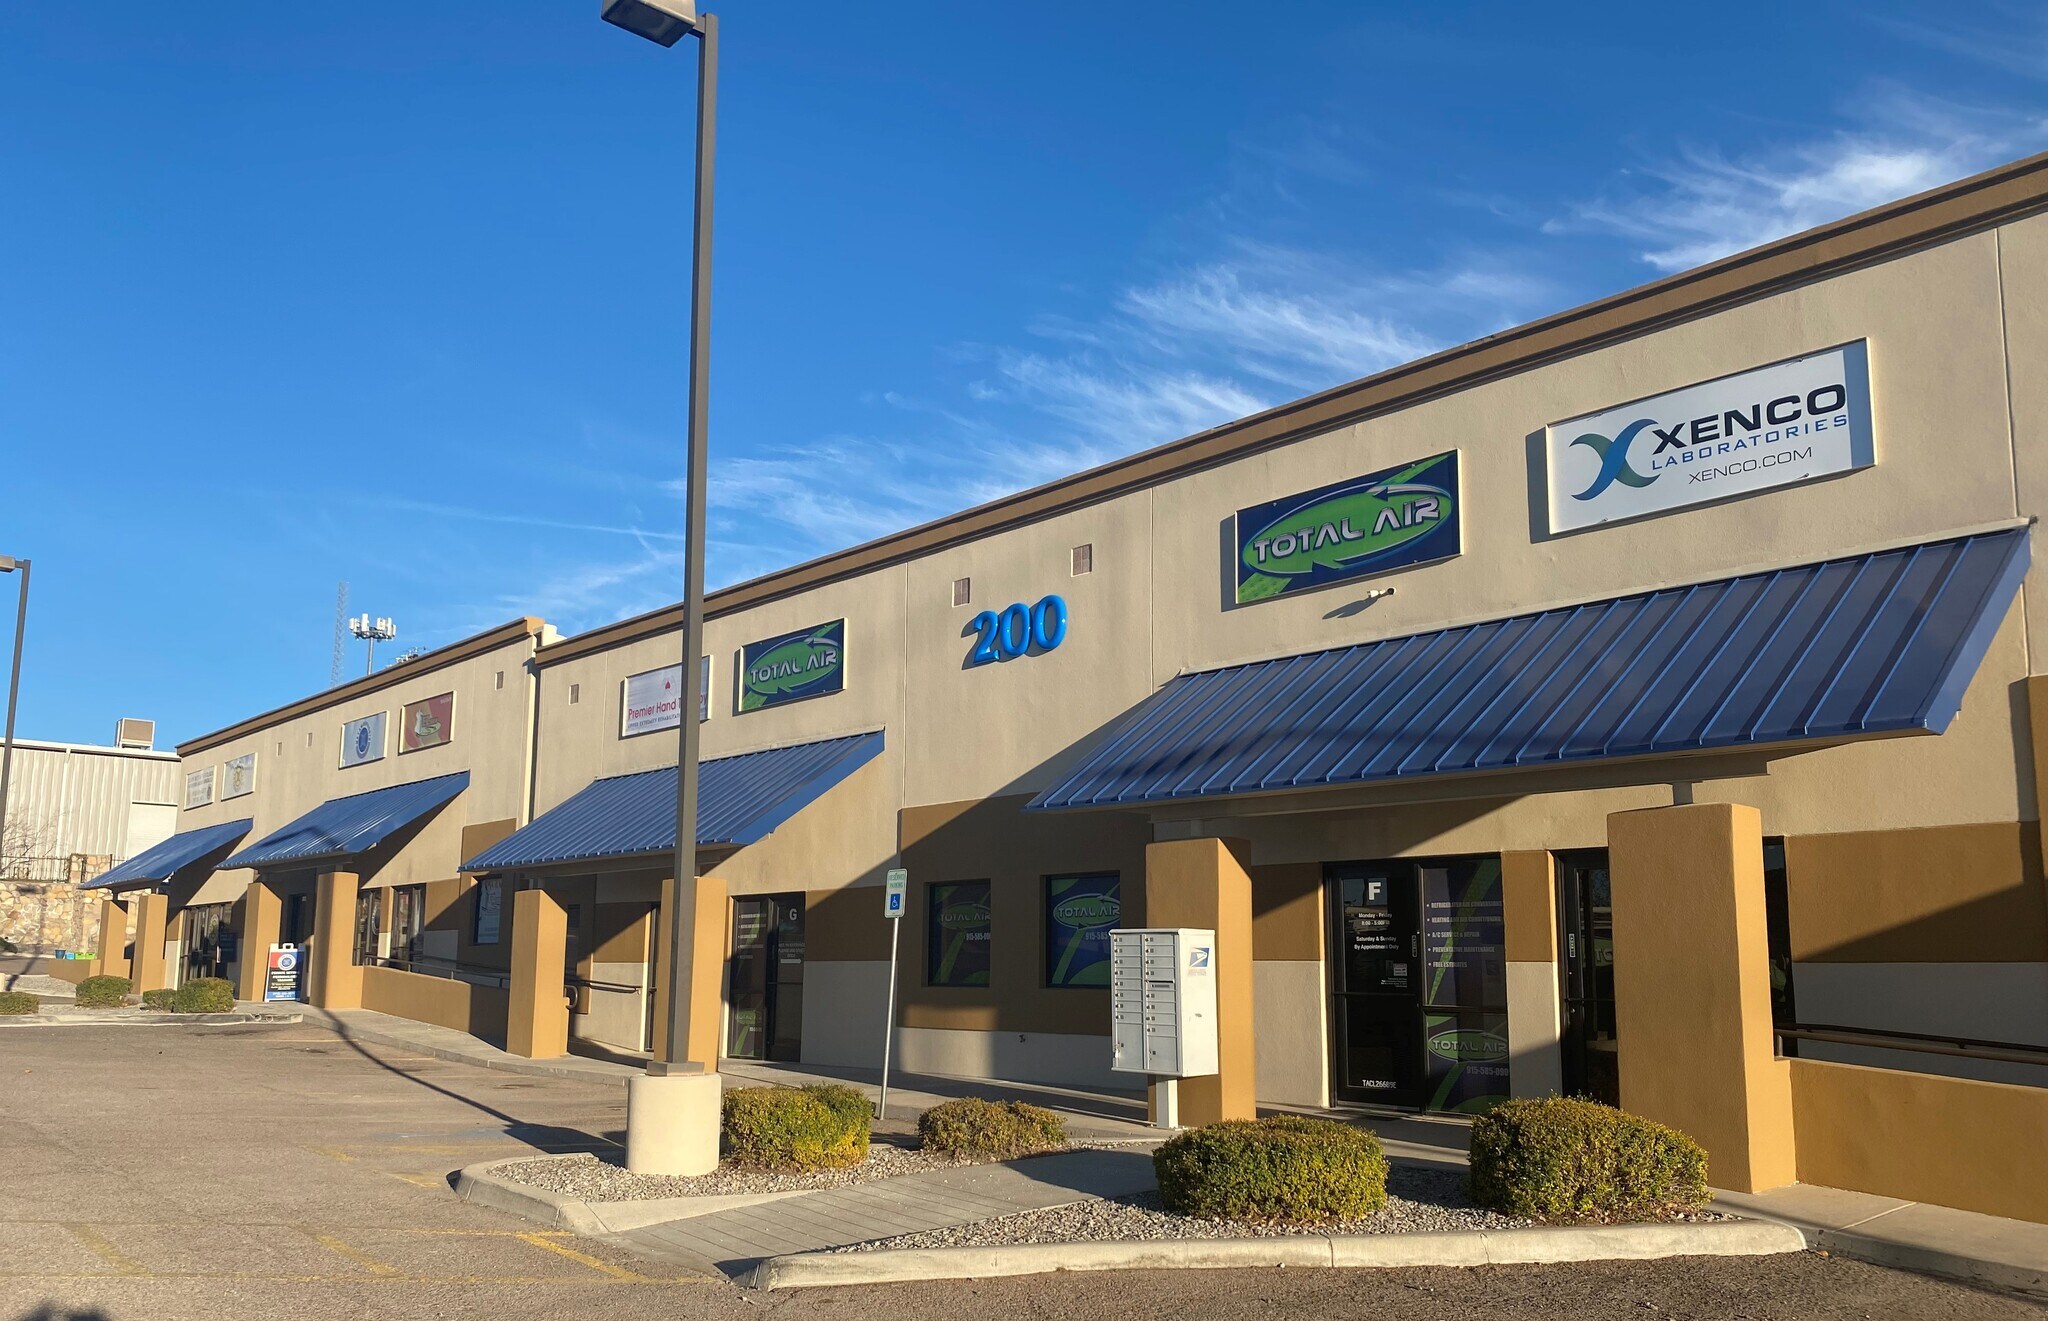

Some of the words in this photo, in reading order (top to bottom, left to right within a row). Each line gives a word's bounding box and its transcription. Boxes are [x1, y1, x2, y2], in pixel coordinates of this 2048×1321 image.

[1652, 384, 1846, 455] XENCO
[1652, 414, 1848, 470] LABORATORIES
[1688, 447, 1813, 485] XENCO.COM
[1253, 518, 1364, 563] TOTAL
[1372, 495, 1441, 536] AIR
[973, 594, 1068, 664] 200
[750, 660, 803, 685] TOTAL
[806, 648, 837, 670] AIR
[628, 705, 655, 720] Premier
[656, 698, 677, 713] Hand
[1368, 882, 1381, 900] F
[789, 908, 798, 921] G
[940, 913, 970, 922] TOTAL
[974, 912, 991, 920] AIR
[1057, 906, 1096, 917] TOTAL
[1099, 905, 1120, 915] AIR
[1432, 1040, 1478, 1051] TOTAL
[1483, 1042, 1507, 1053] AIR
